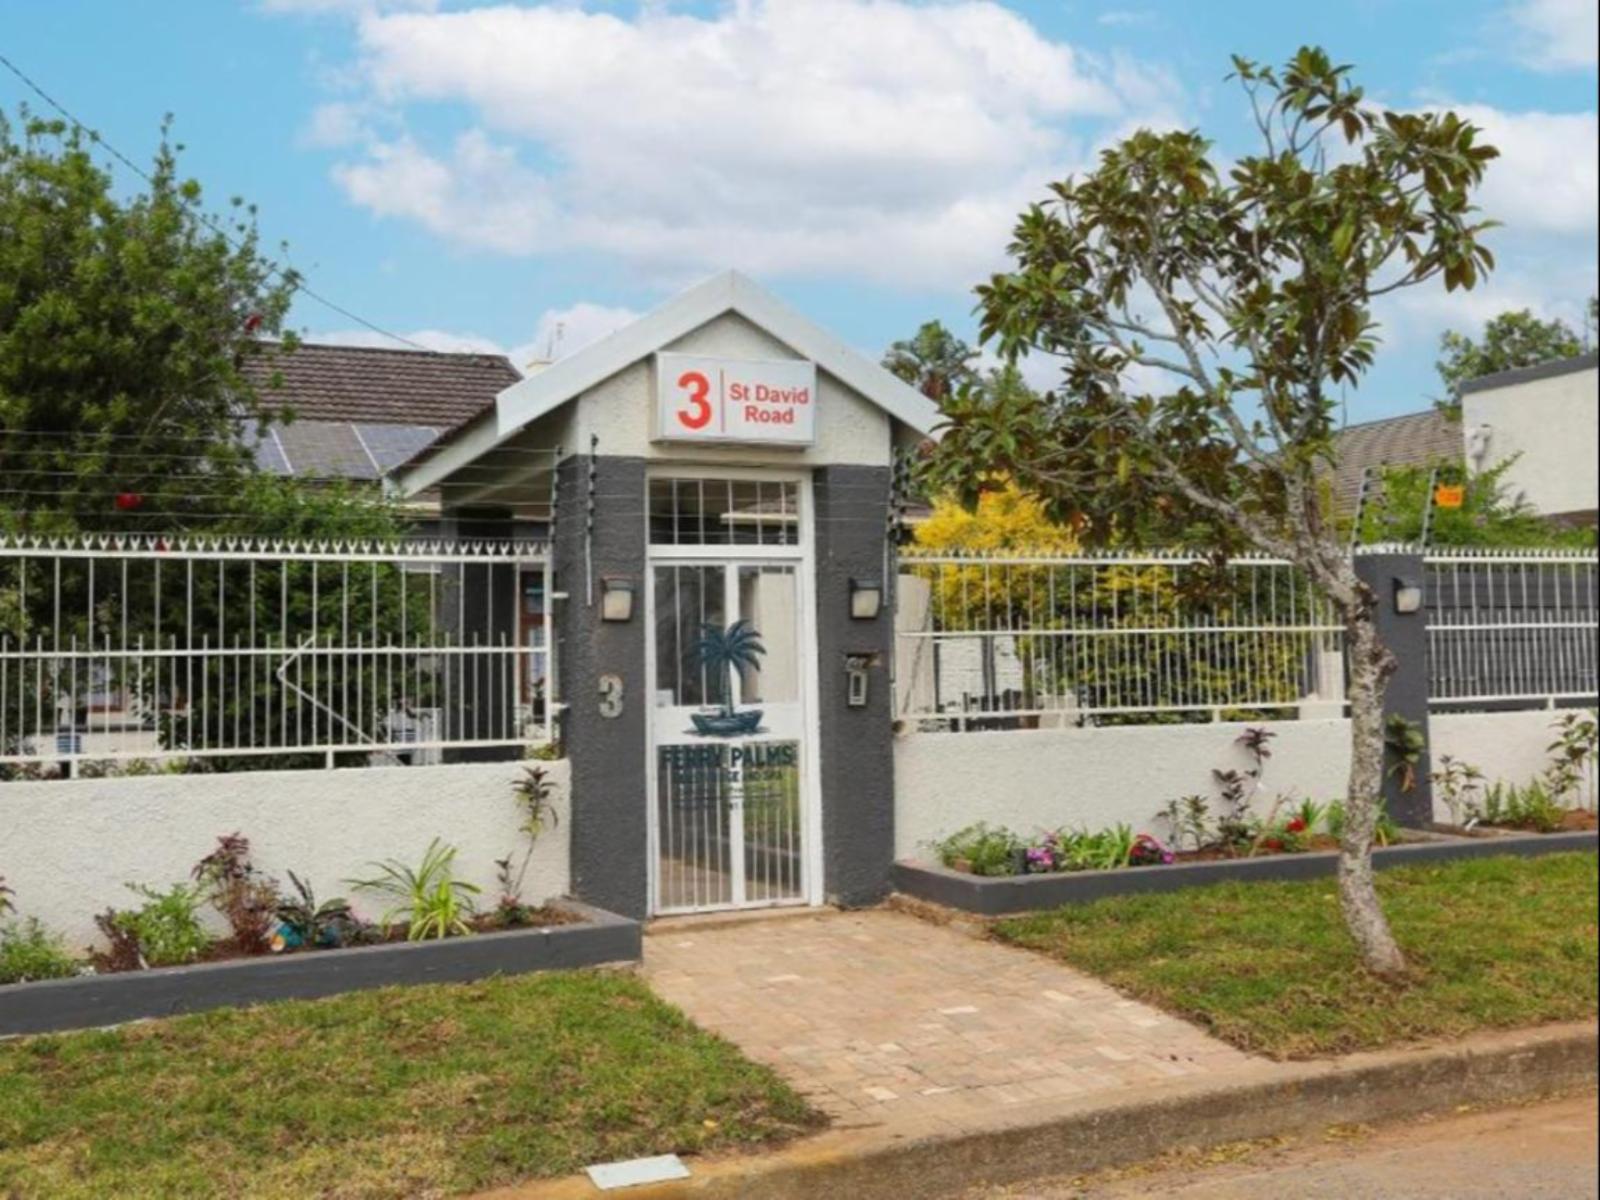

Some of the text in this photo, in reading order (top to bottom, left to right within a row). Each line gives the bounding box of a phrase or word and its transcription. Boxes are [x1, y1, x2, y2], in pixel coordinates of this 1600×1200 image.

[677, 371, 712, 430] 3
[730, 383, 809, 404] St David
[745, 405, 794, 423] Road
[599, 674, 623, 718] 3
[731, 745, 793, 768] PALMS
